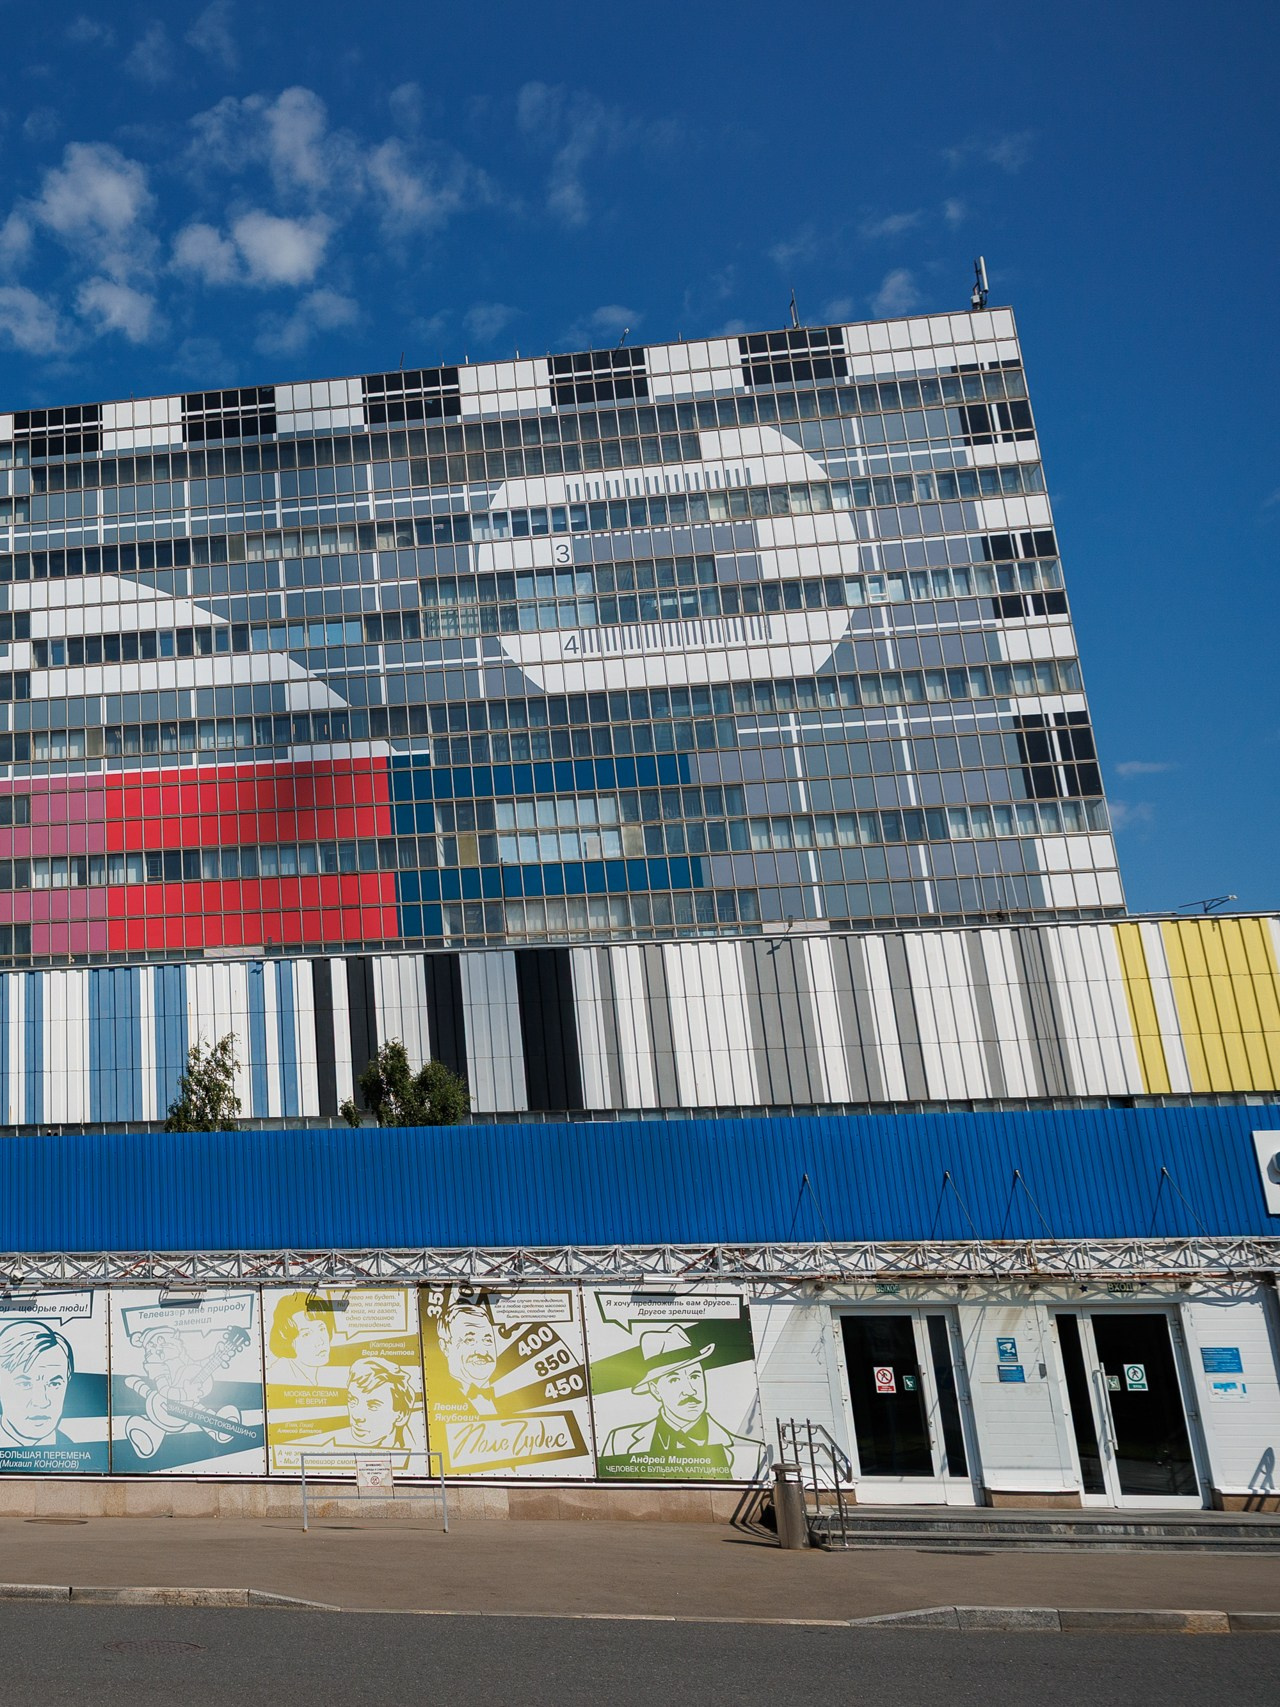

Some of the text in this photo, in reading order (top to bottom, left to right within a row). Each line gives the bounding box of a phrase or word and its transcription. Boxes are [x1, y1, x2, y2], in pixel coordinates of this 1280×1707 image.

[555, 544, 570, 563] 3
[563, 635, 579, 654] 4
[1108, 1282, 1133, 1291] ВХОД
[18, 1304, 56, 1313] щедрые
[59, 1304, 88, 1313] люди!
[207, 1302, 246, 1314] природу
[638, 1308, 667, 1316] Другое
[174, 1317, 212, 1326] заменил
[518, 1326, 553, 1356] 400
[534, 1349, 570, 1377] 850
[545, 1374, 583, 1399] 450
[433, 1402, 469, 1411] Леонид
[167, 1403, 188, 1416] ЗИМА
[194, 1413, 257, 1439] ПРОСТОКВАШИНО
[434, 1413, 480, 1423] Якубович
[453, 1420, 568, 1460] Поле Чудес
[0, 1450, 91, 1459] БОЛЬШАЯ ПЕРЕМЕНА
[0, 1460, 79, 1469] (Михаил КОНОНОВ)
[630, 1455, 712, 1465] Андрей Миронов
[605, 1465, 639, 1473] ЧЕЛОВЕК
[647, 1465, 684, 1473] БУЛЬВАРА
[685, 1466, 730, 1474] КАПУЦИНОВ
